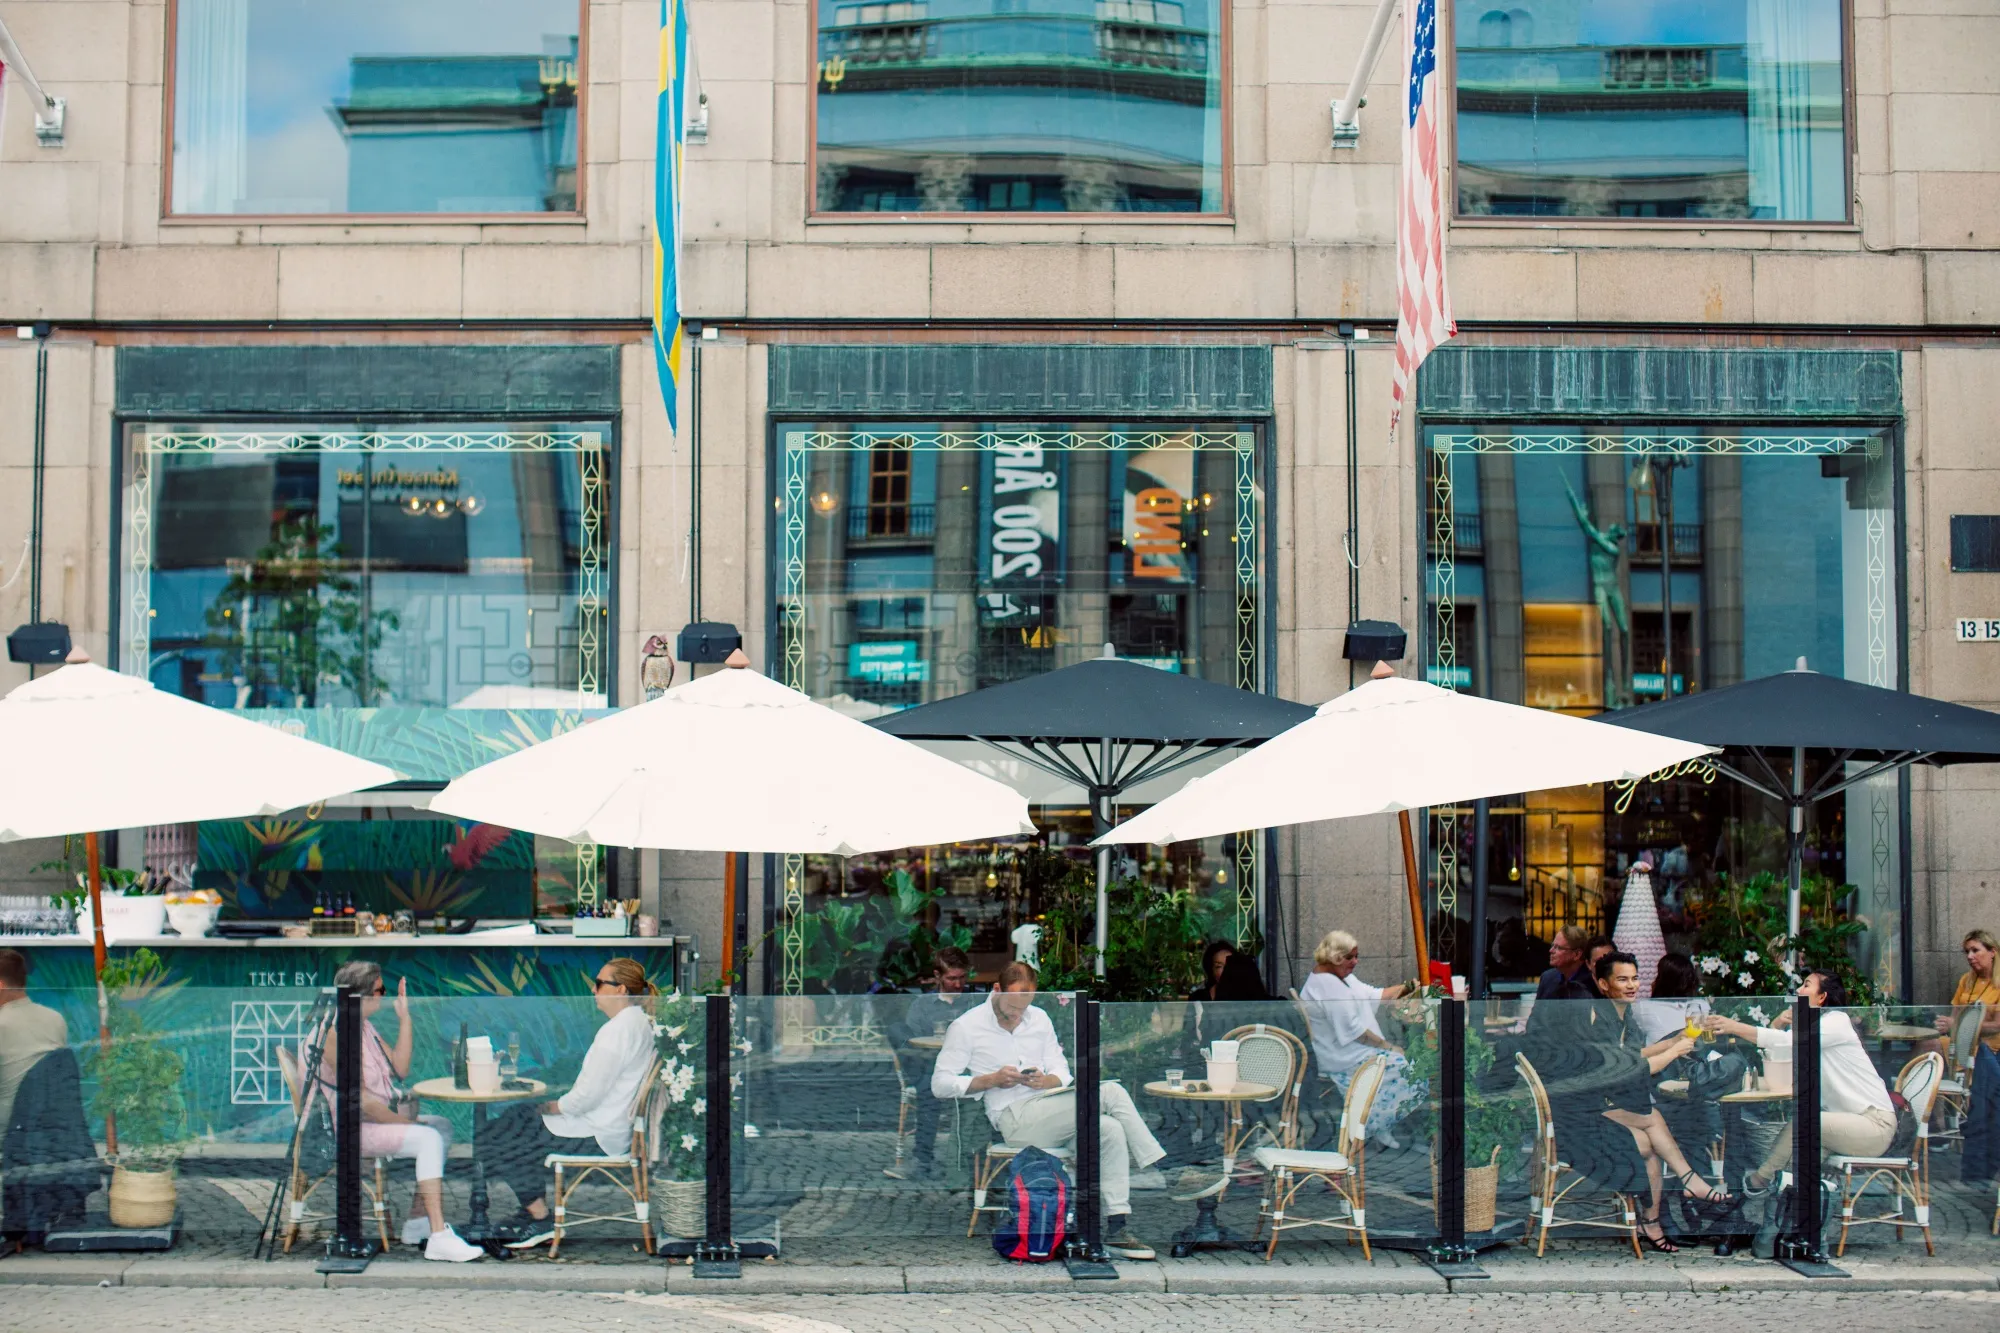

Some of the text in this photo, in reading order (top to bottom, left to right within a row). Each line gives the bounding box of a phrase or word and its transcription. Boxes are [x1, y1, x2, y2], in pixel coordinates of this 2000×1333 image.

[1960, 620, 2000, 639] 13 15
[249, 971, 319, 987] TIKI BY
